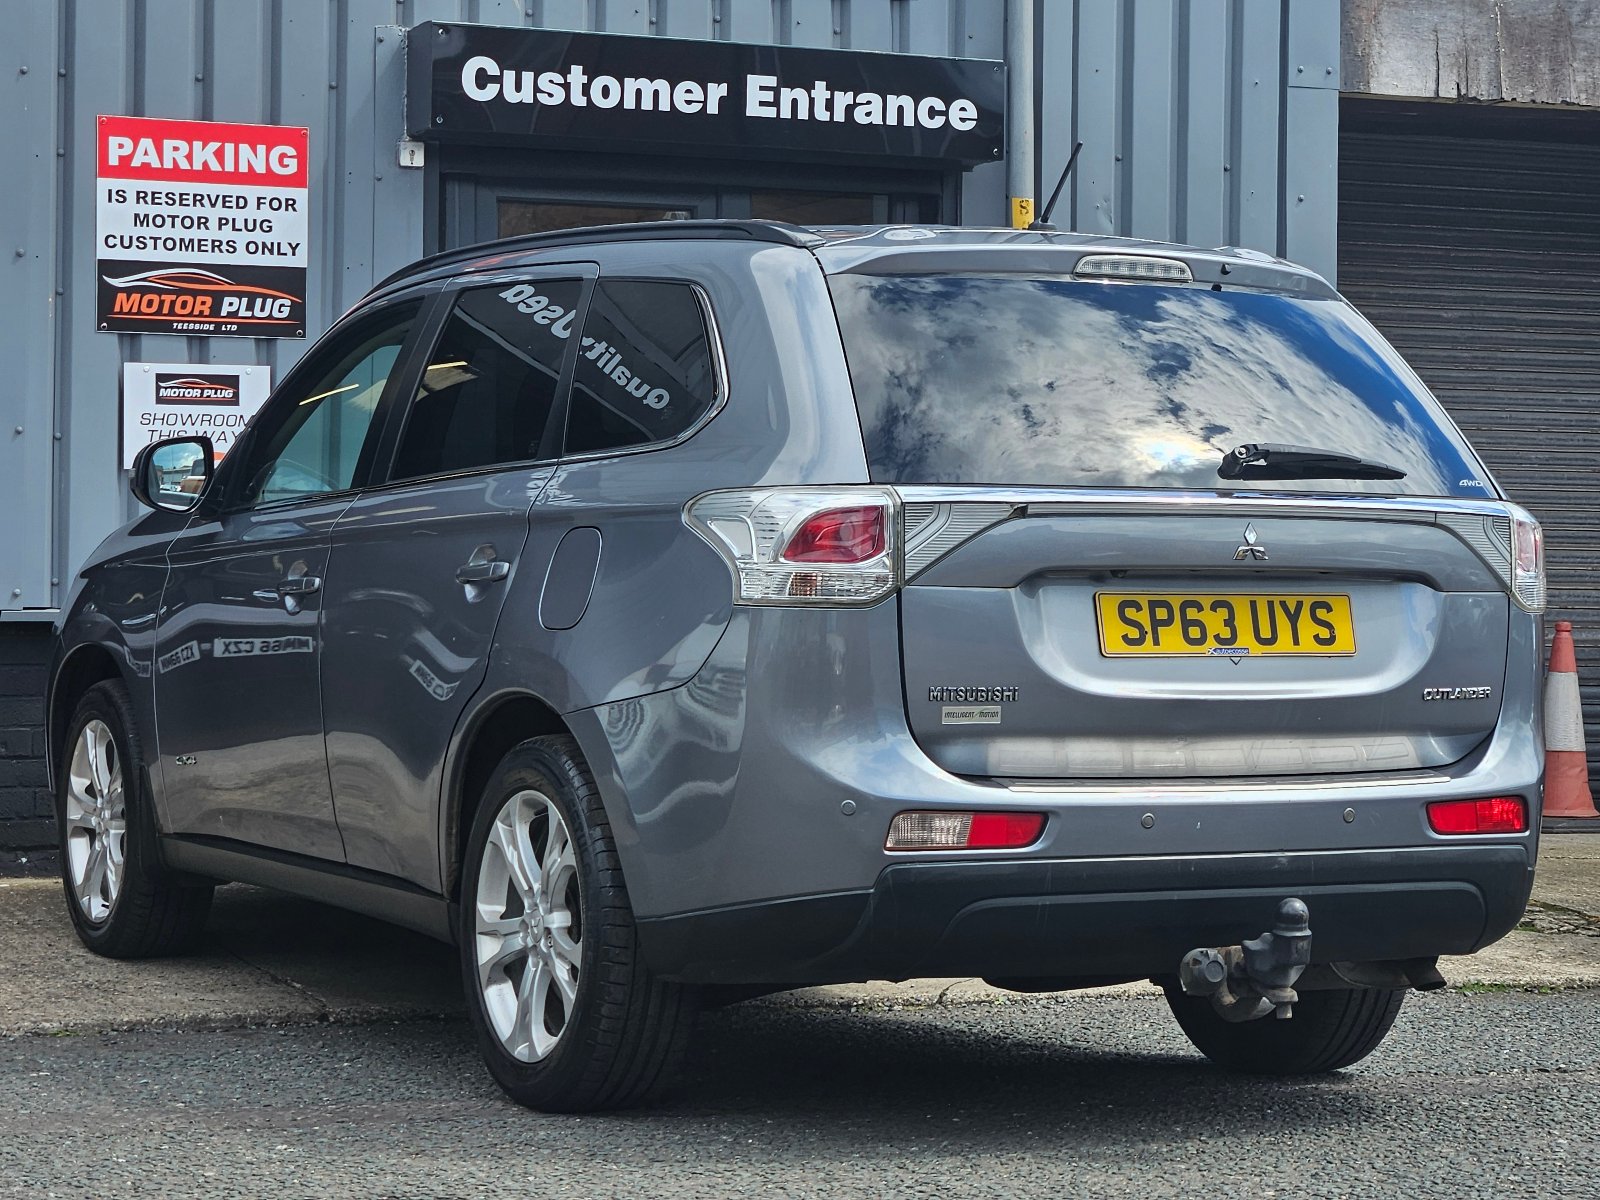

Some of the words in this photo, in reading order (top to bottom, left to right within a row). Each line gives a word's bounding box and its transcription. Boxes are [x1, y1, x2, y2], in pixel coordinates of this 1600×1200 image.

[461, 55, 727, 115] Customer
[745, 74, 978, 132] Entrance
[108, 136, 298, 175] PARKING
[107, 189, 127, 204] IS
[135, 190, 248, 210] RESERVED
[256, 196, 298, 212] FOR
[133, 213, 210, 231] MOTOR
[218, 217, 273, 233] PLUG
[104, 234, 237, 254] CUSTOMERS
[245, 240, 301, 256] ONLY
[113, 292, 213, 316] MOTOR
[220, 296, 291, 319] PLUG
[172, 322, 216, 331] TEESSIDE
[159, 388, 202, 398] MOTOR
[203, 389, 234, 398] PLUG
[1458, 479, 1483, 487] 4WD
[1117, 599, 1238, 647] SP63
[1249, 600, 1337, 647] UYS
[928, 686, 1019, 702] MITSUBISHI
[1422, 686, 1492, 701] OUTLANDER
